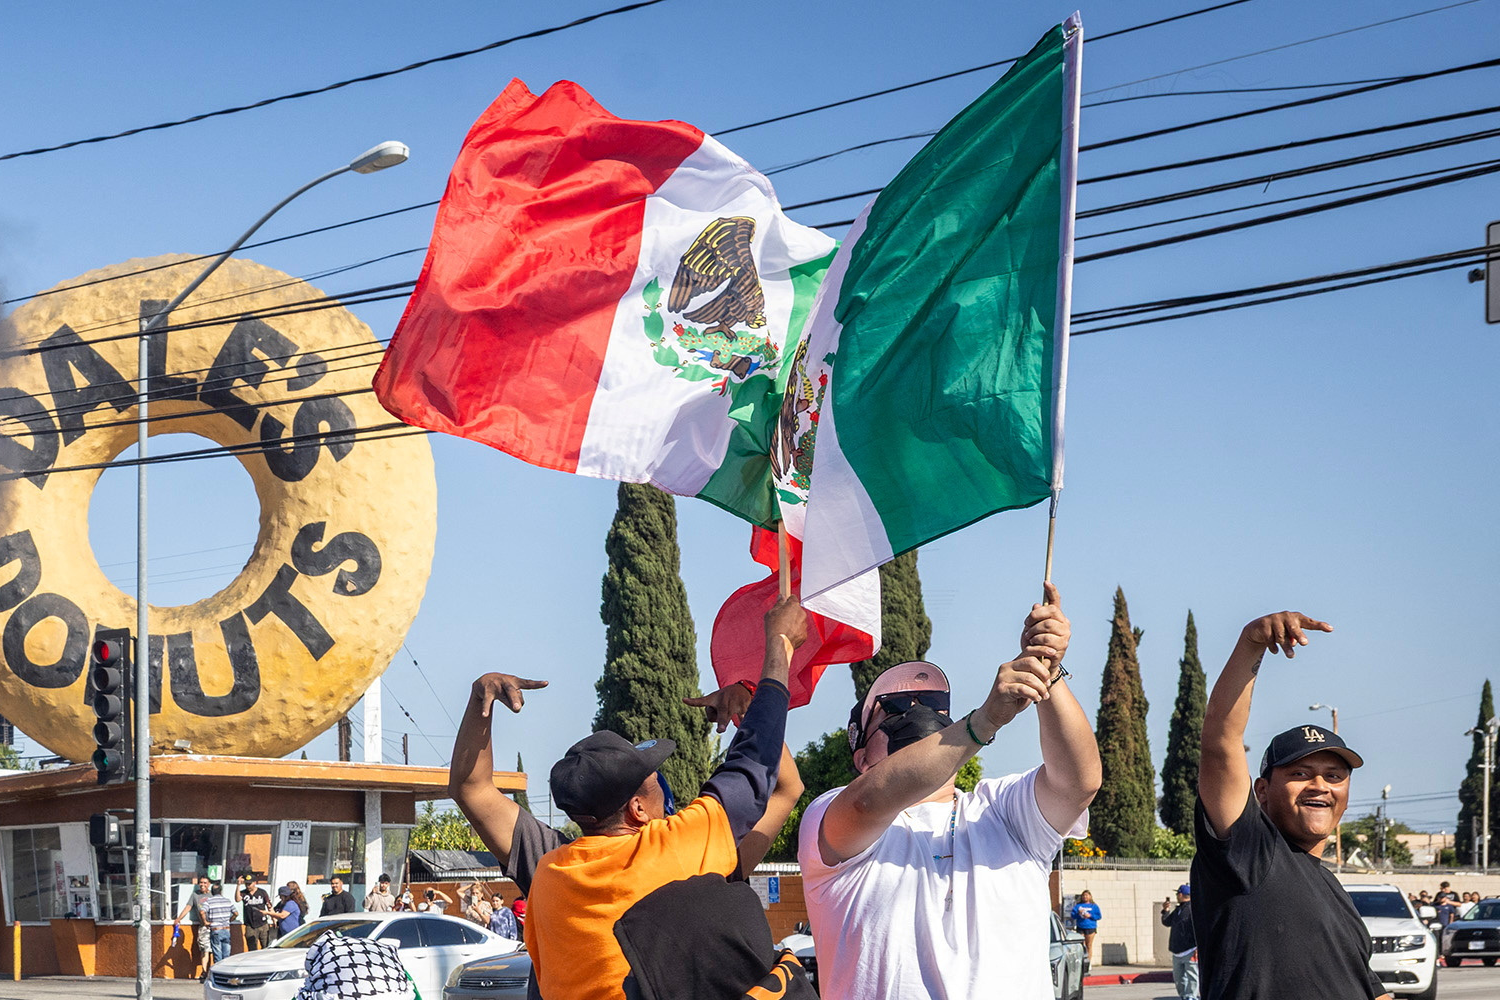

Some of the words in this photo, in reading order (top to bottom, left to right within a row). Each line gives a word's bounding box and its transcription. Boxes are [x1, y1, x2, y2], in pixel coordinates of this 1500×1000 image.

[1301, 726, 1326, 743] LA
[286, 821, 308, 830] 15904
[209, 868, 217, 878] A
